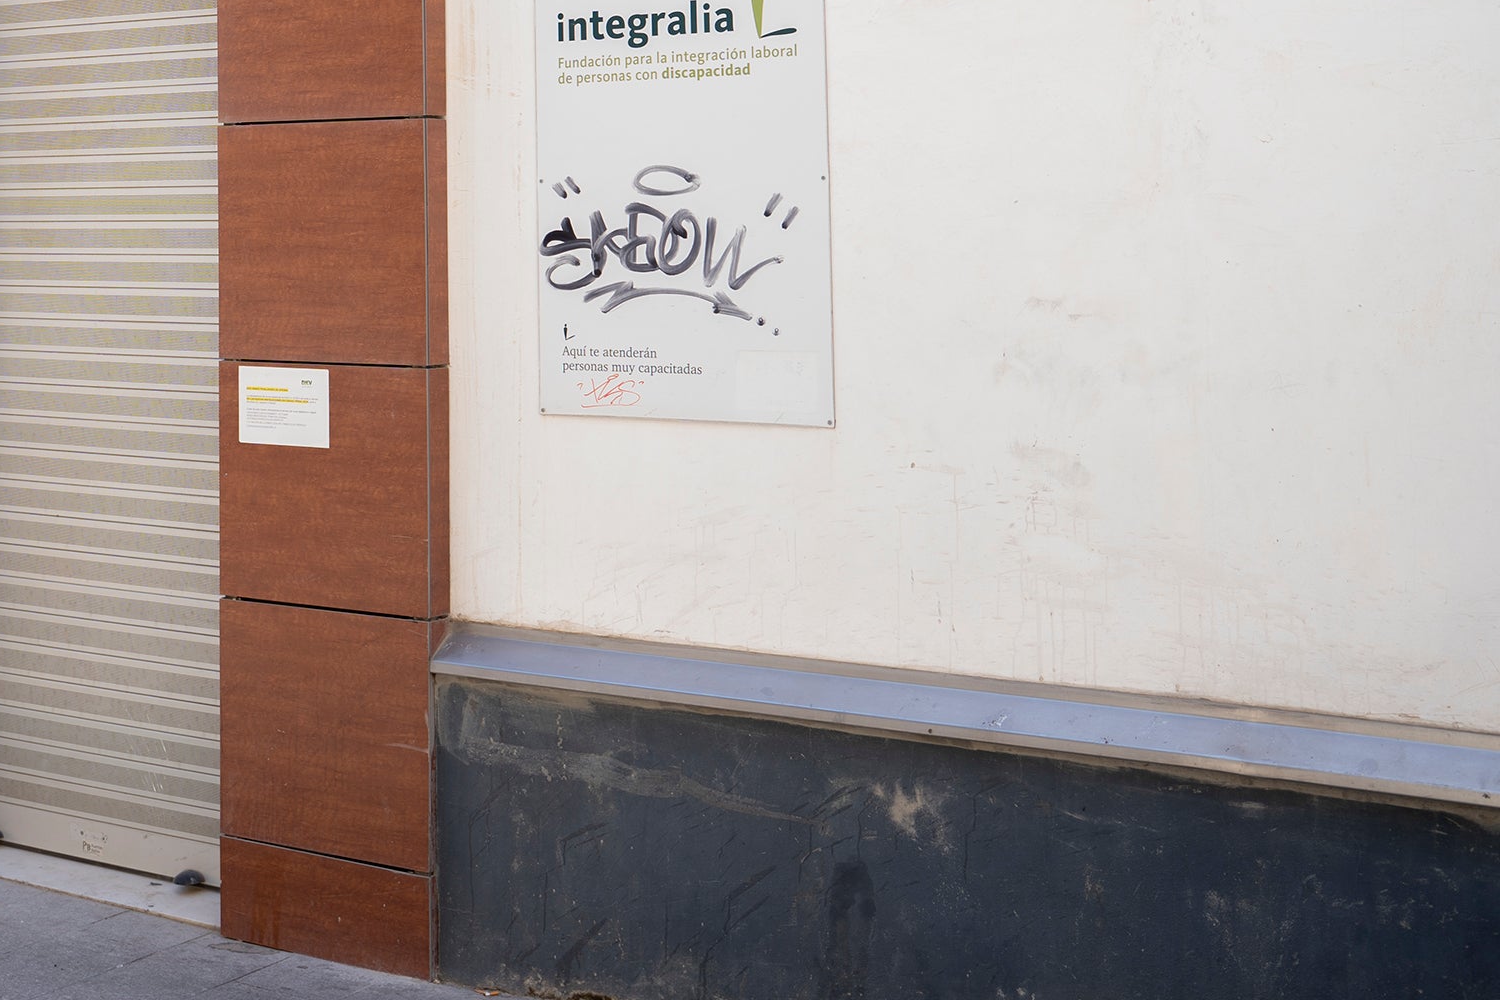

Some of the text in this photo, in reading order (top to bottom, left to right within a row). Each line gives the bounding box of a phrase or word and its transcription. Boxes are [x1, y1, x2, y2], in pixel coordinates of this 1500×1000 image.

[557, 0, 735, 49] integralia
[558, 44, 798, 69] Fundación para la integración laboral
[558, 63, 751, 87] de personas con discapacidad
[562, 345, 657, 359] Aquí te atenderán
[562, 361, 703, 377] personas muy capacitadas
